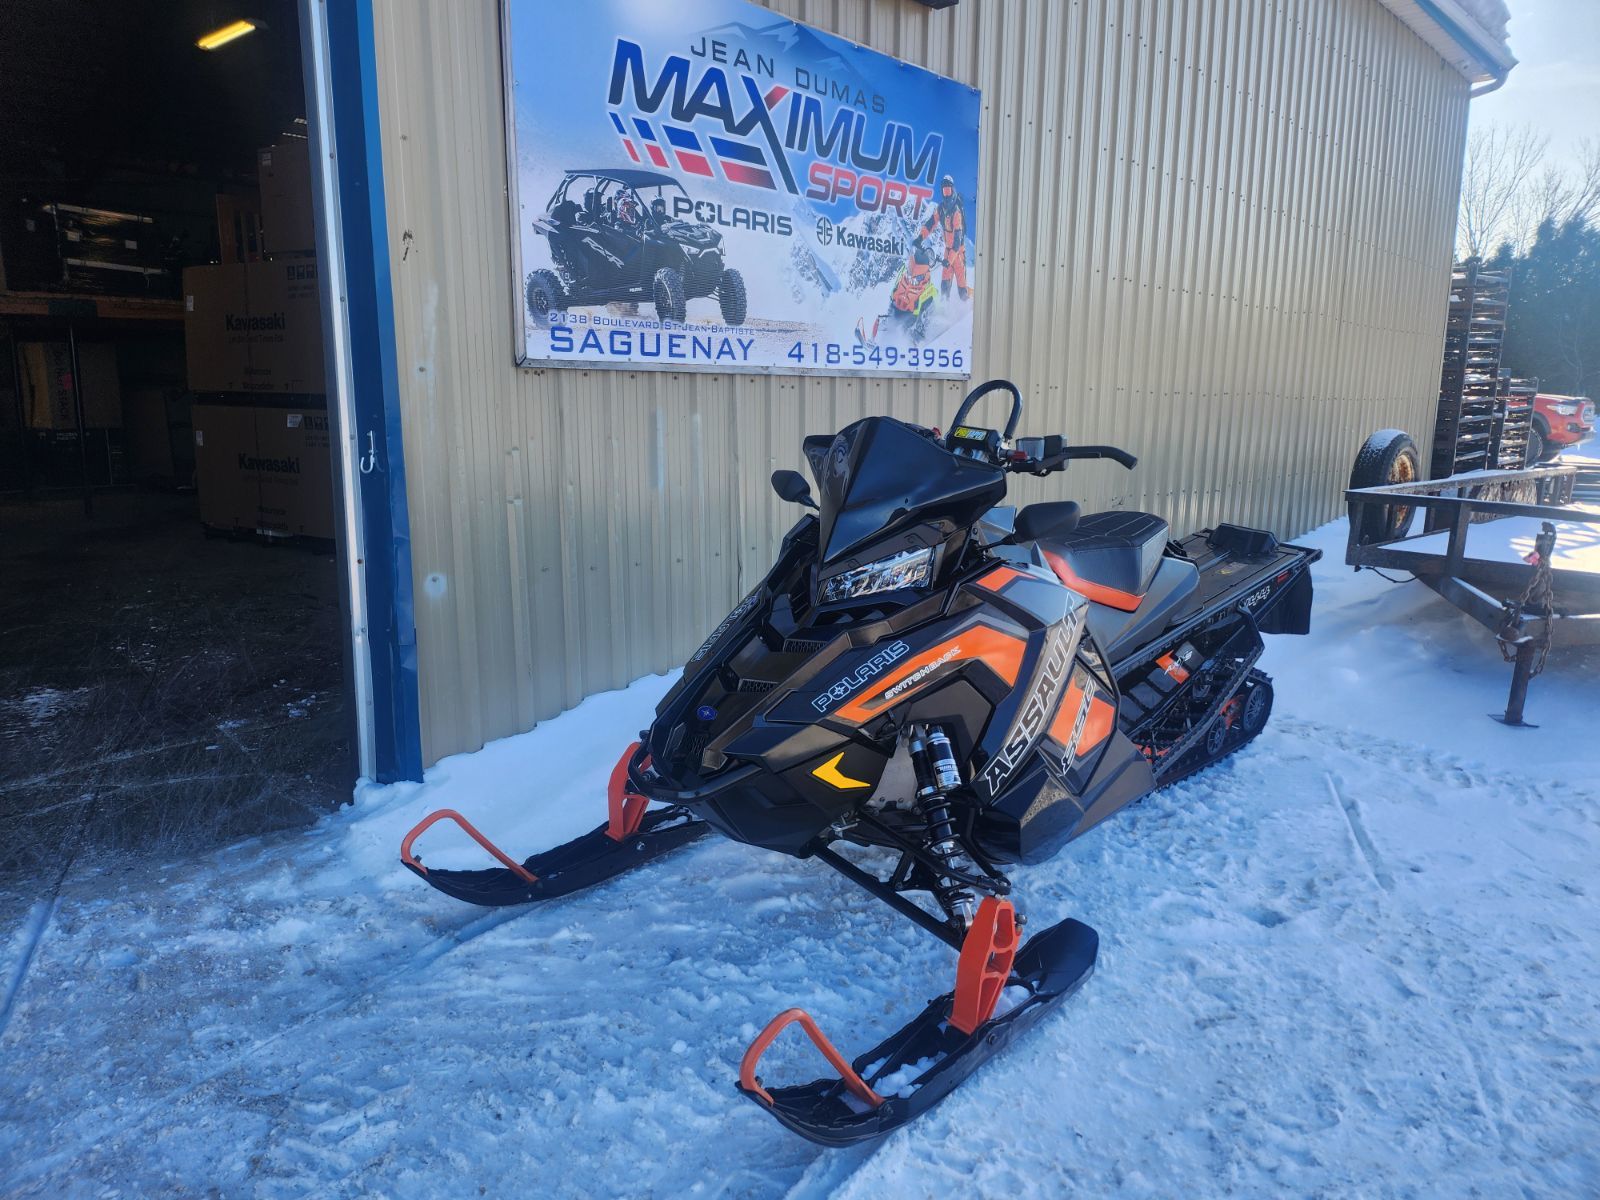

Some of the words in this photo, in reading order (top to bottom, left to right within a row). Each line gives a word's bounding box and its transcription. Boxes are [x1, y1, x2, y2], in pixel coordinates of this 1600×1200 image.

[690, 37, 775, 79] JEAN
[795, 68, 886, 115] DUMAS
[608, 38, 943, 195] MAXIMUM
[805, 162, 933, 221] SPORT
[673, 196, 793, 237] POLARIS
[836, 225, 904, 256] Kawasaki
[225, 312, 285, 331] Kawasaki
[550, 312, 588, 325] 2138
[550, 326, 754, 361] SAGUENAY
[787, 341, 963, 368] 418-549-3956
[238, 453, 300, 474] Kawasaki
[811, 640, 910, 713] POLARIS
[984, 591, 1078, 797] ASSAULT
